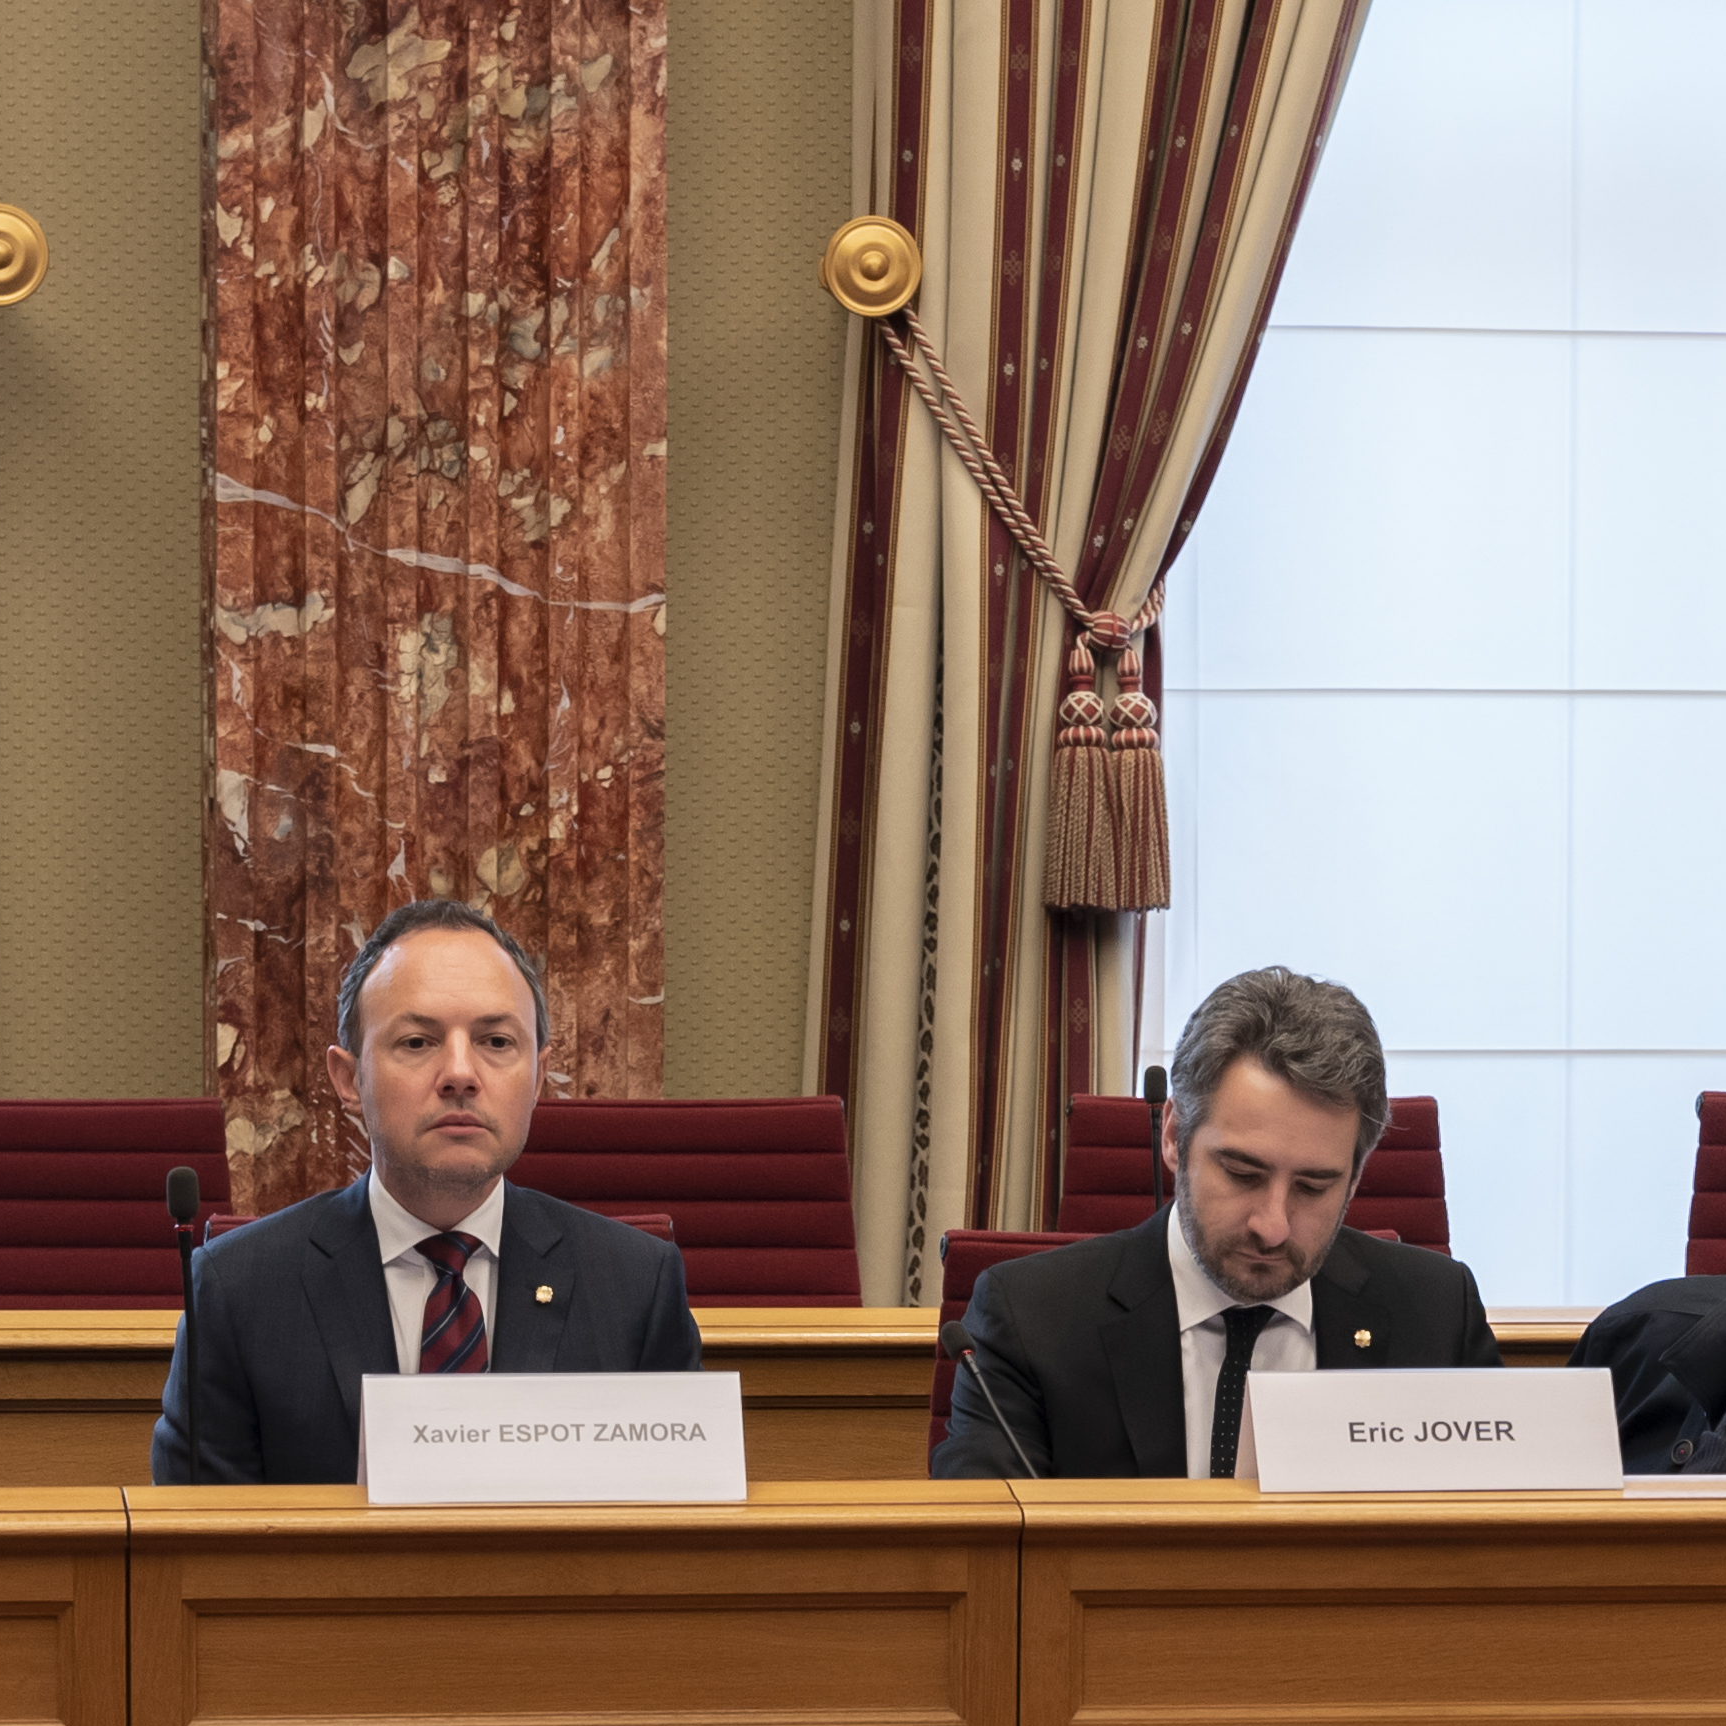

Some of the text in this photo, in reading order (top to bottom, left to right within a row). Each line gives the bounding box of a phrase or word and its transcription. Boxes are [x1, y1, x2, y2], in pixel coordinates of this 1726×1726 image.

[413, 1422, 706, 1443] Xavier ESPOT ZAMORA
[1348, 1420, 1515, 1442] Eric JOVER
